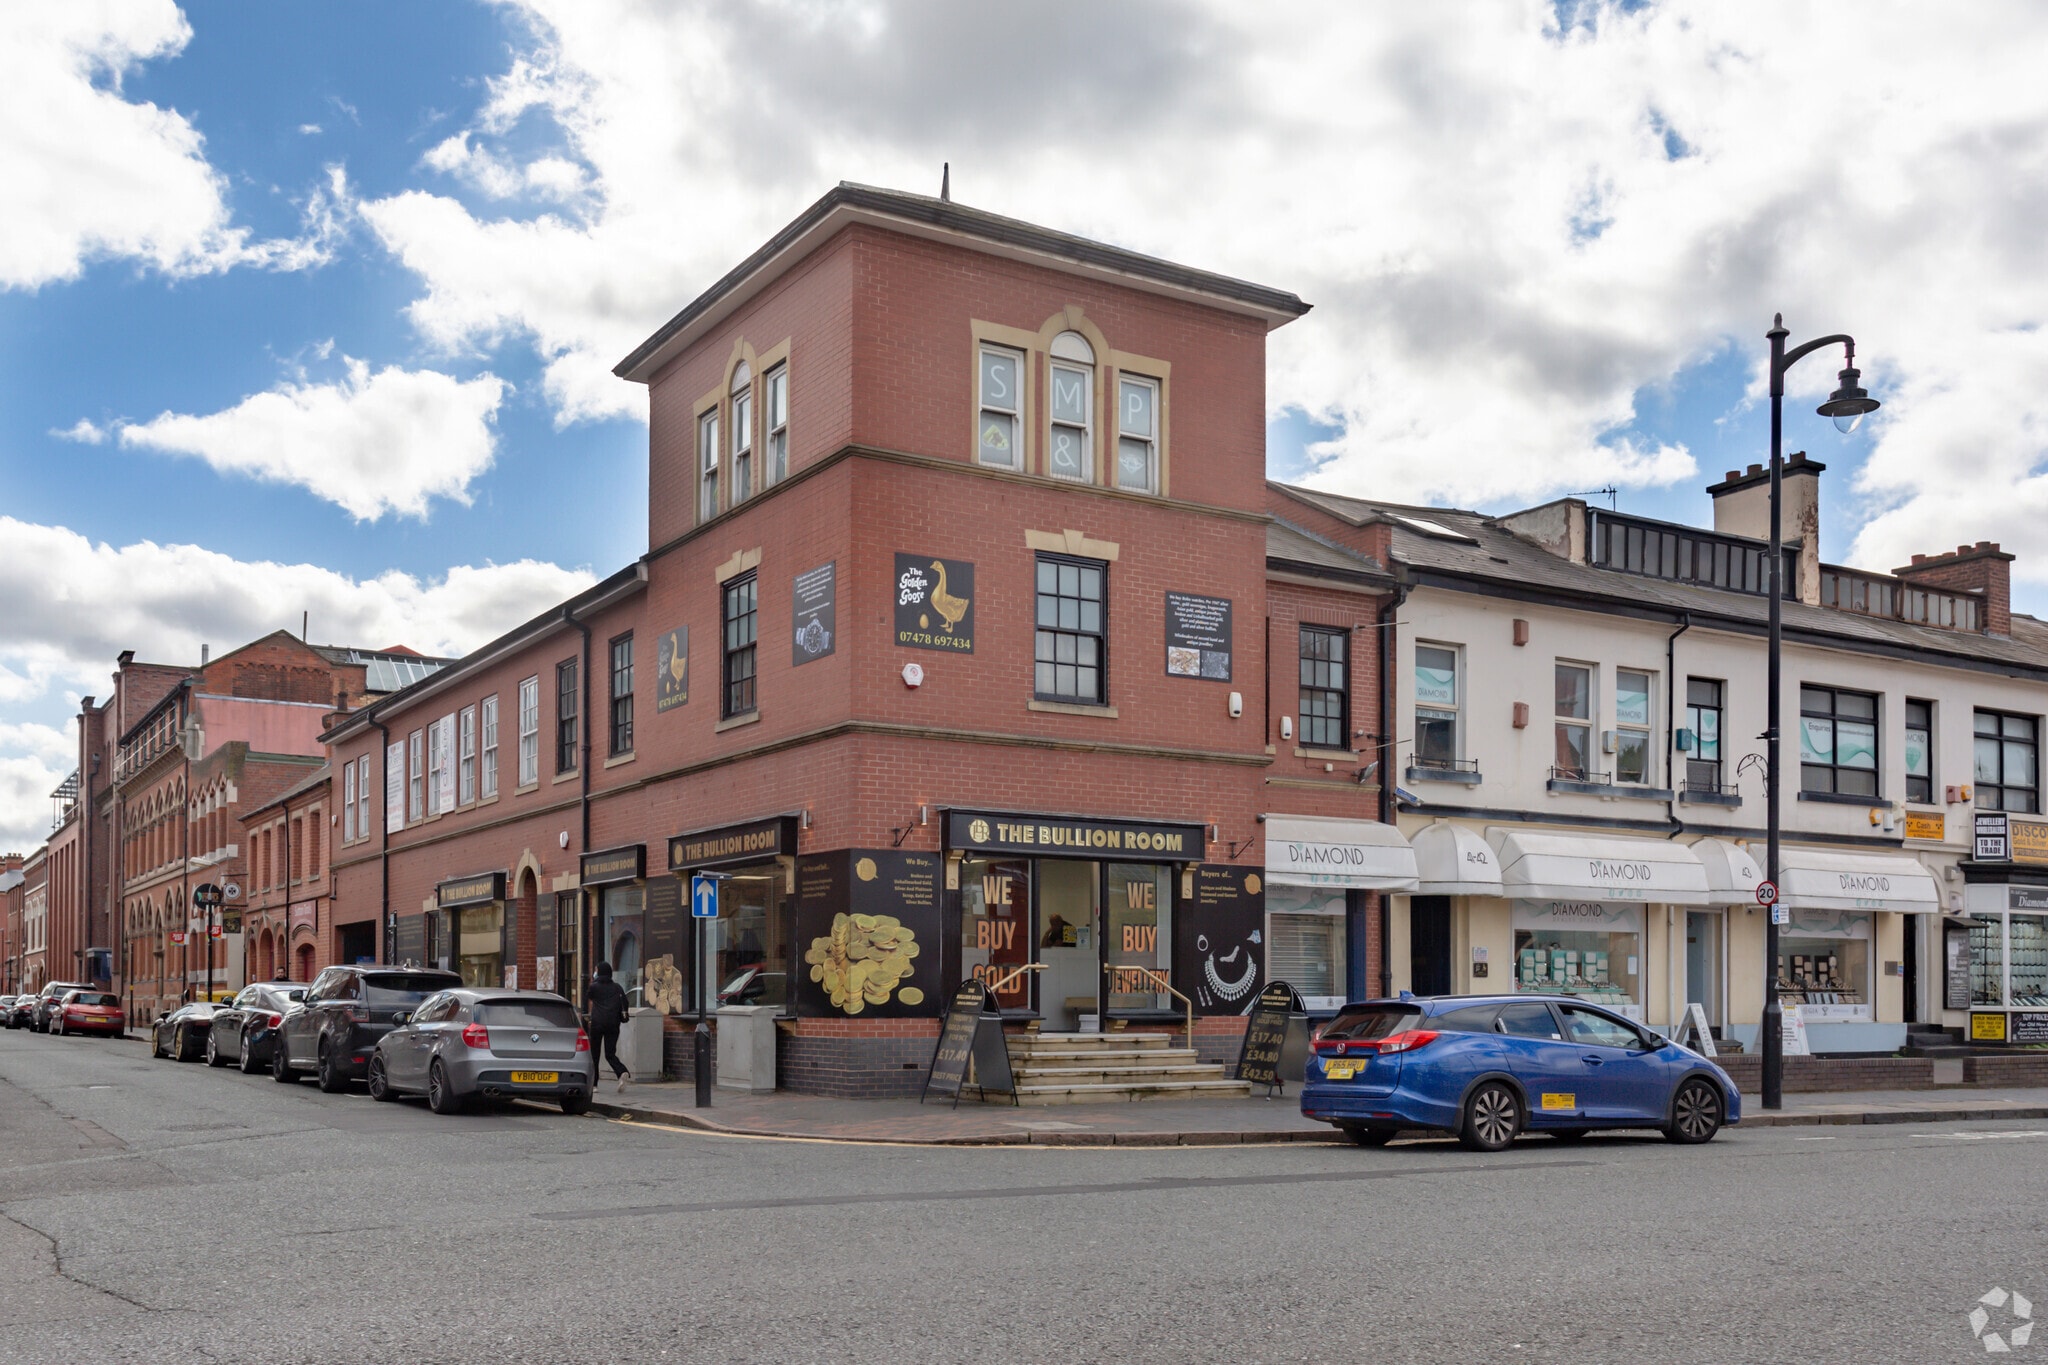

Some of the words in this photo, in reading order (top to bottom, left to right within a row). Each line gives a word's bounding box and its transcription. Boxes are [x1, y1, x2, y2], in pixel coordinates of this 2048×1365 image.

[909, 567, 923, 576] The
[899, 573, 929, 590] Golden
[899, 588, 925, 605] Goose
[900, 631, 931, 645] 07478
[934, 635, 971, 649] 697434
[1916, 821, 1931, 830] Cash
[685, 842, 702, 860] THE
[703, 835, 742, 858] BULLION
[743, 829, 775, 852] ROOM
[997, 823, 1035, 844] THE
[1039, 826, 1121, 849] BULLION
[1124, 831, 1183, 852] ROOM
[1991, 839, 2001, 847] THE
[1981, 846, 2001, 854] TRADE
[590, 863, 599, 875] THE
[599, 860, 620, 873] BULLION
[620, 857, 636, 870] ROOM
[1201, 870, 1220, 878] Buyers
[447, 888, 455, 900] THE
[455, 884, 475, 899] BULLION
[476, 881, 491, 896] ROOM
[982, 874, 1013, 905] WE
[1127, 881, 1154, 909] WE
[1759, 888, 1774, 899] 20
[976, 919, 1016, 950] BUY
[1122, 924, 1157, 953] BUY
[972, 963, 1021, 994] GOLD
[1109, 968, 1170, 994] JEWELLERY
[1251, 1032, 1283, 1044] £17.40
[937, 1049, 967, 1061] £17.40
[1246, 1050, 1278, 1062] £34.80
[517, 1072, 536, 1081] YB10
[1241, 1067, 1274, 1080] £42.50
